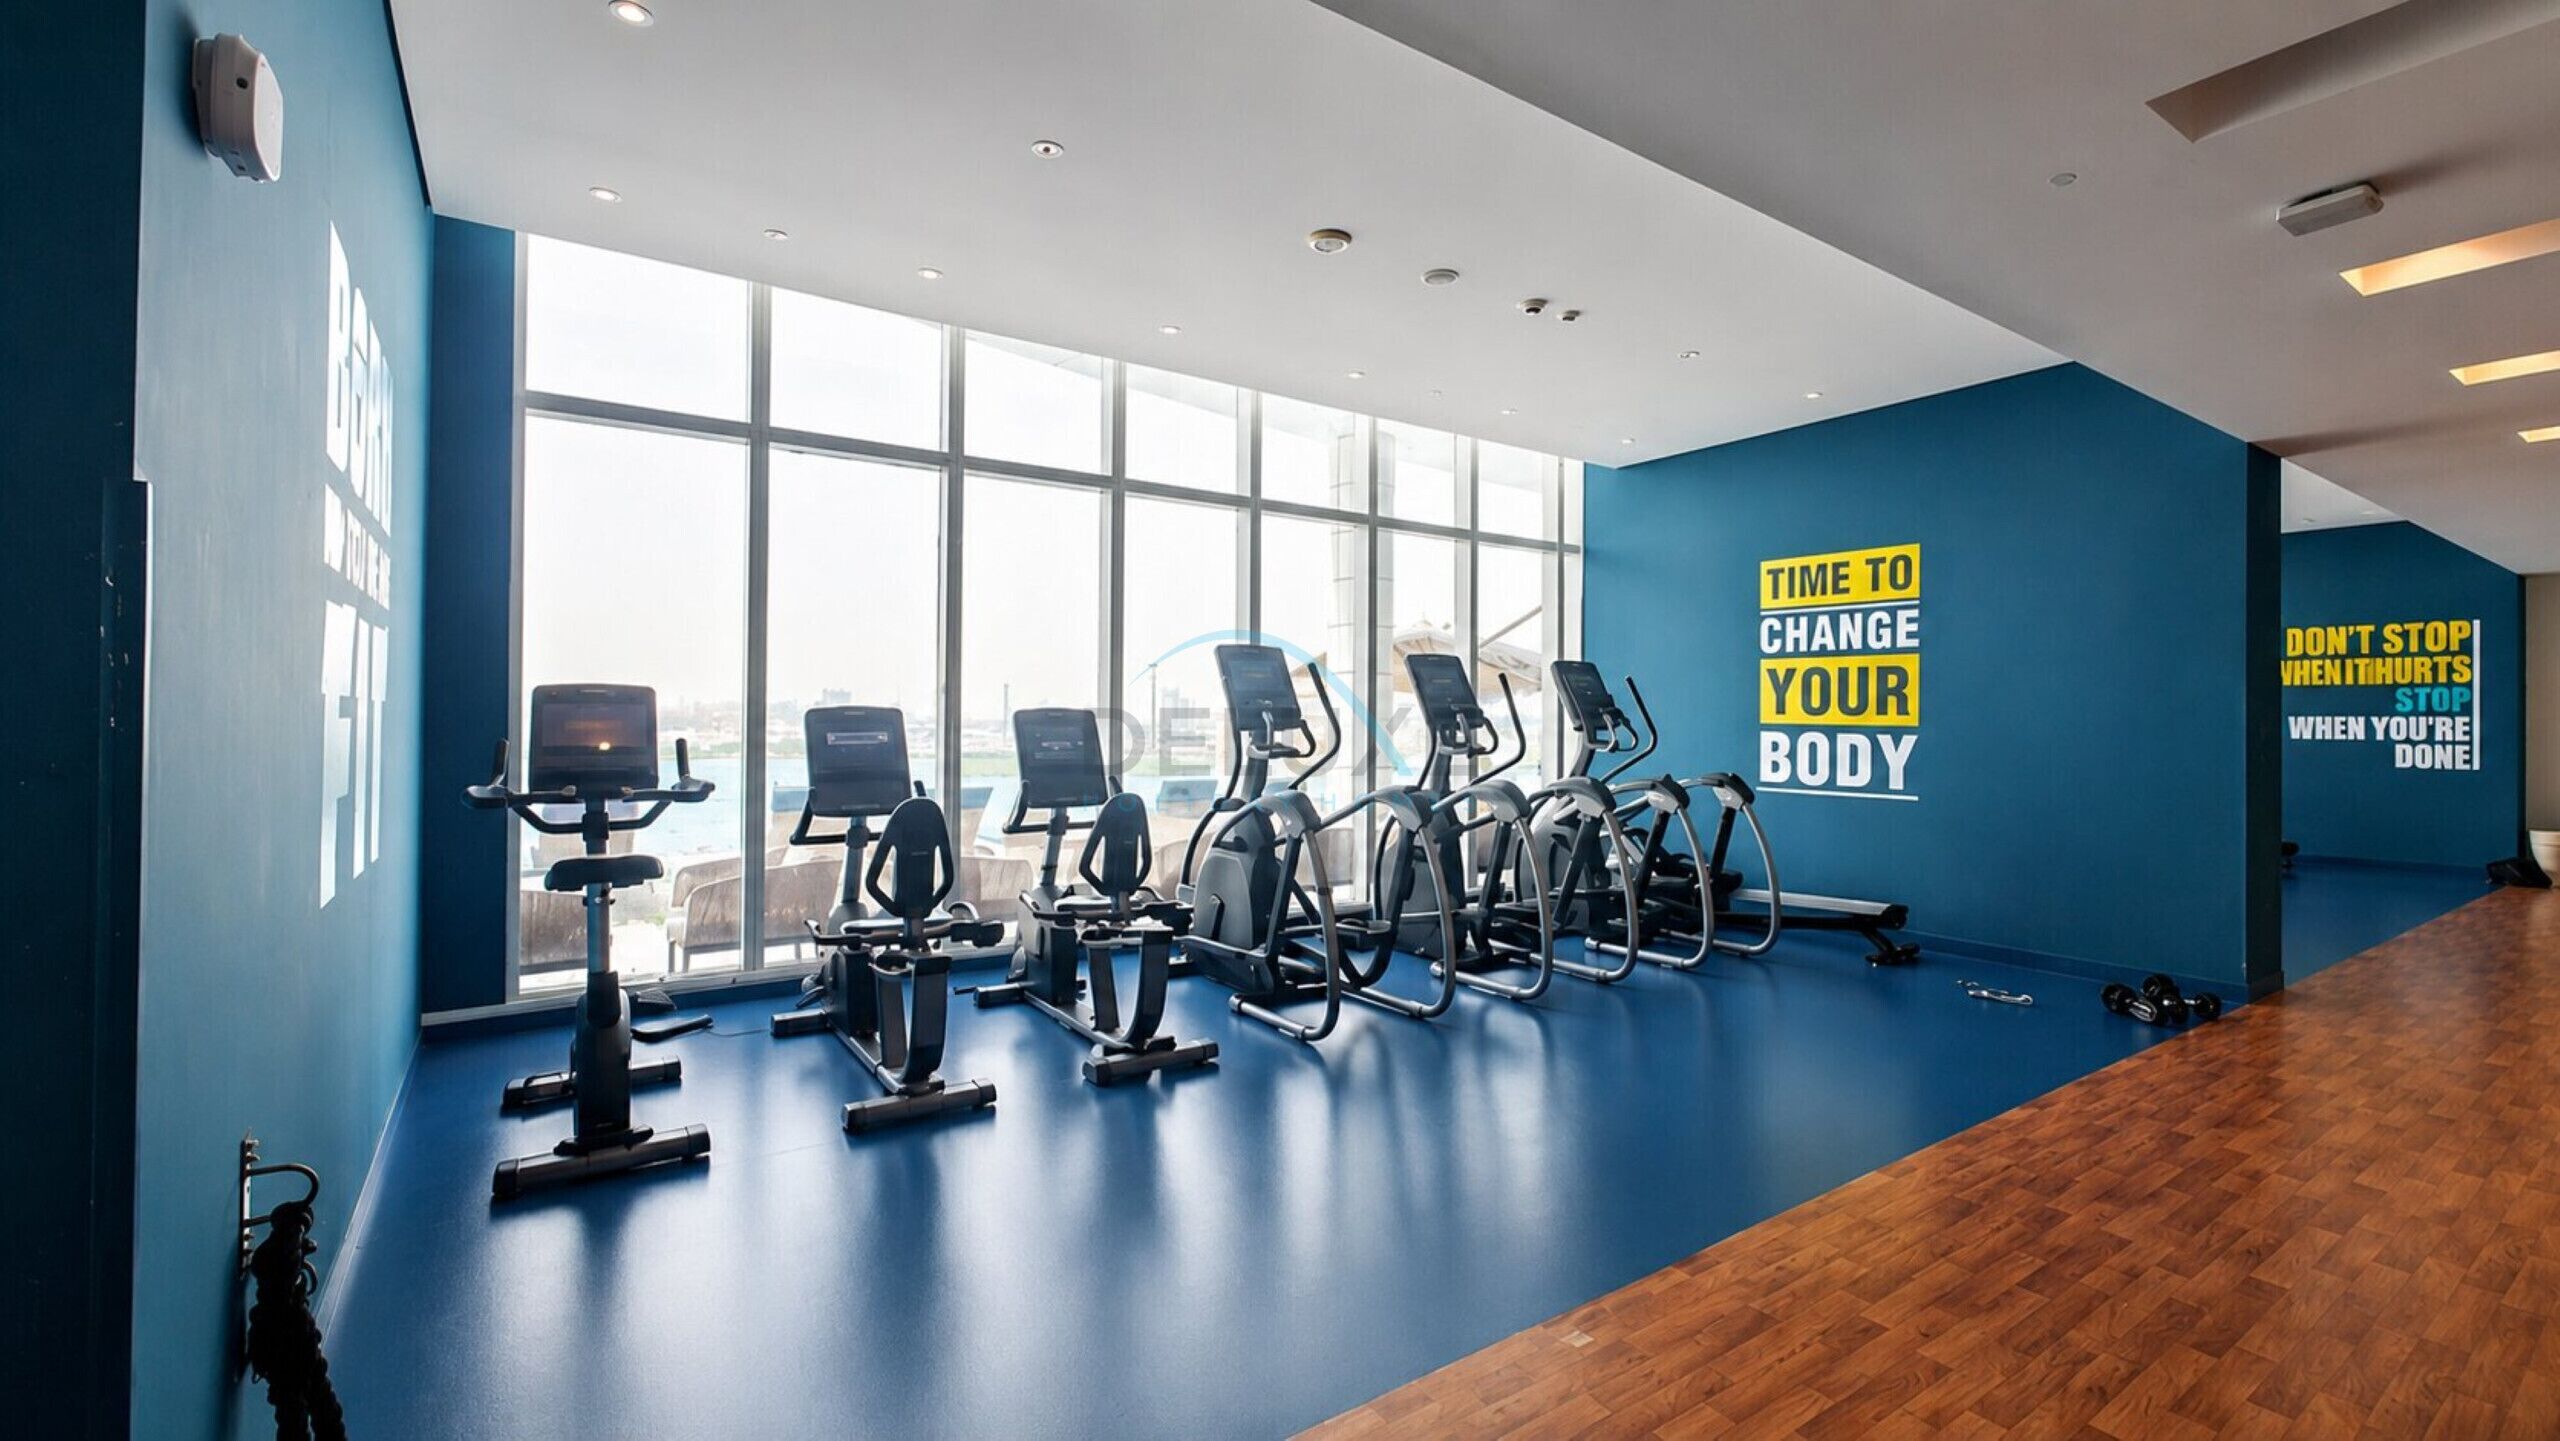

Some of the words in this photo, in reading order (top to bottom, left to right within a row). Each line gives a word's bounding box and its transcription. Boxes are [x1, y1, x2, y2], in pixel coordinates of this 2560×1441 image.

[1767, 561, 1850, 600] TIME
[1865, 554, 1913, 592] TO
[1760, 608, 1920, 654] CHANGE
[2286, 624, 2375, 656] DON'T
[2382, 620, 2472, 654] STOP
[2375, 655, 2472, 685] HURTS
[1766, 666, 1910, 717] YOUR
[2395, 687, 2471, 712] STOP
[2288, 716, 2365, 740] WHEN
[2370, 716, 2471, 741] YOU'RE
[319, 600, 389, 909] FIT
[1760, 731, 1918, 790] BODY
[2395, 744, 2471, 770] DONE
